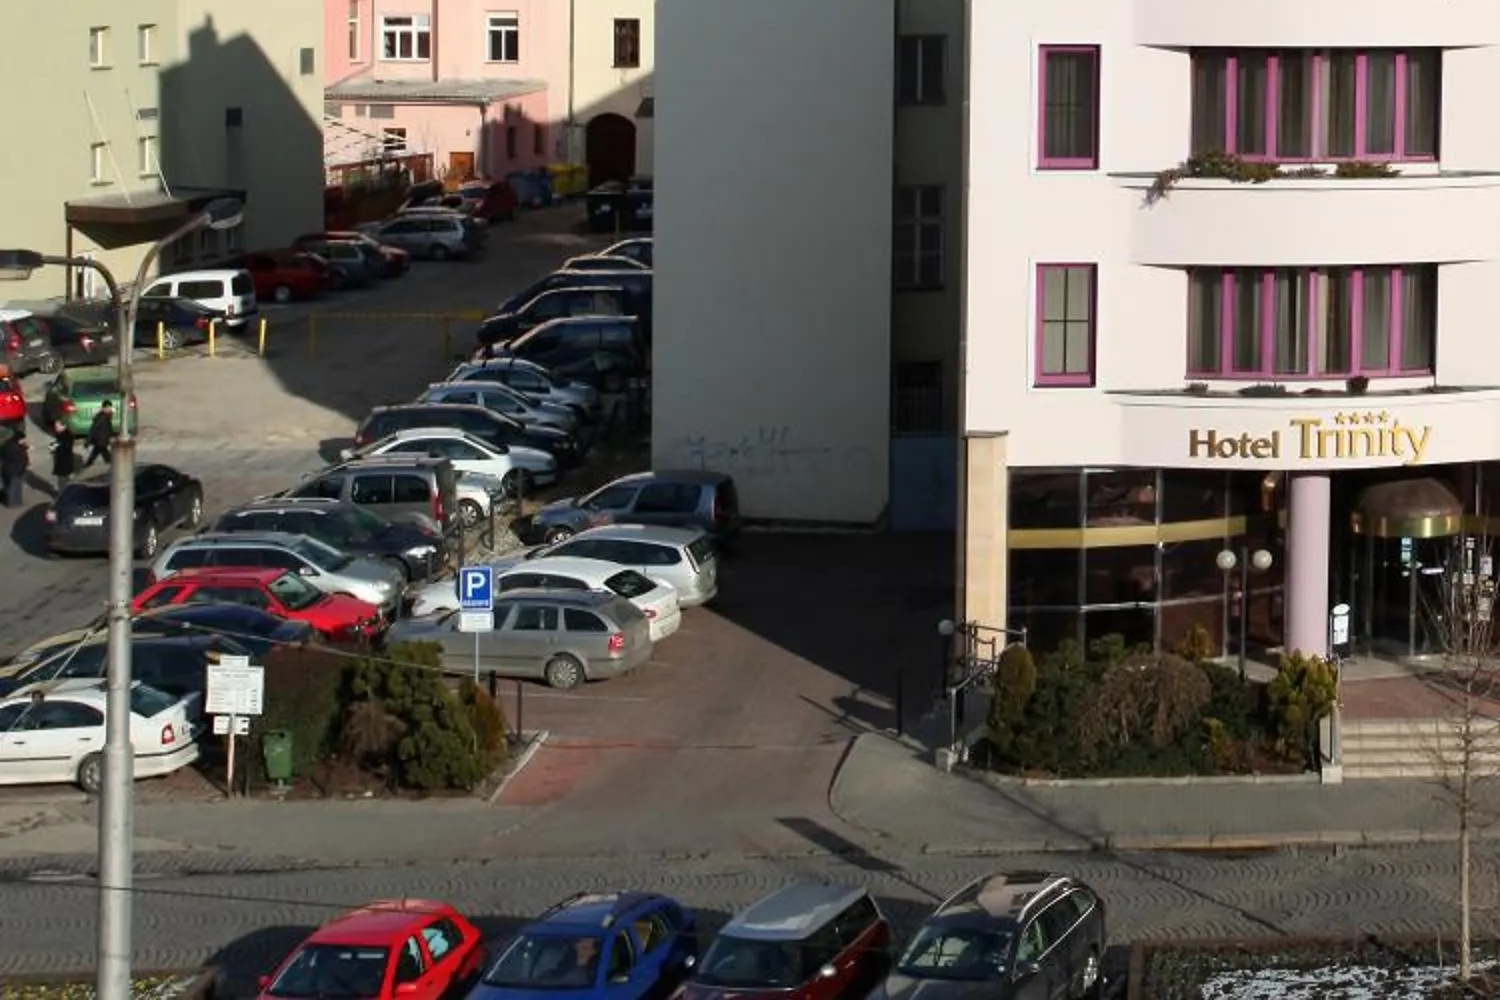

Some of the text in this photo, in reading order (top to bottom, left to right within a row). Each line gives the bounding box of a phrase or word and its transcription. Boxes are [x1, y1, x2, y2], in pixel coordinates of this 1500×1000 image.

[1189, 418, 1432, 466] Hotel Trinity
[467, 571, 486, 598] P
